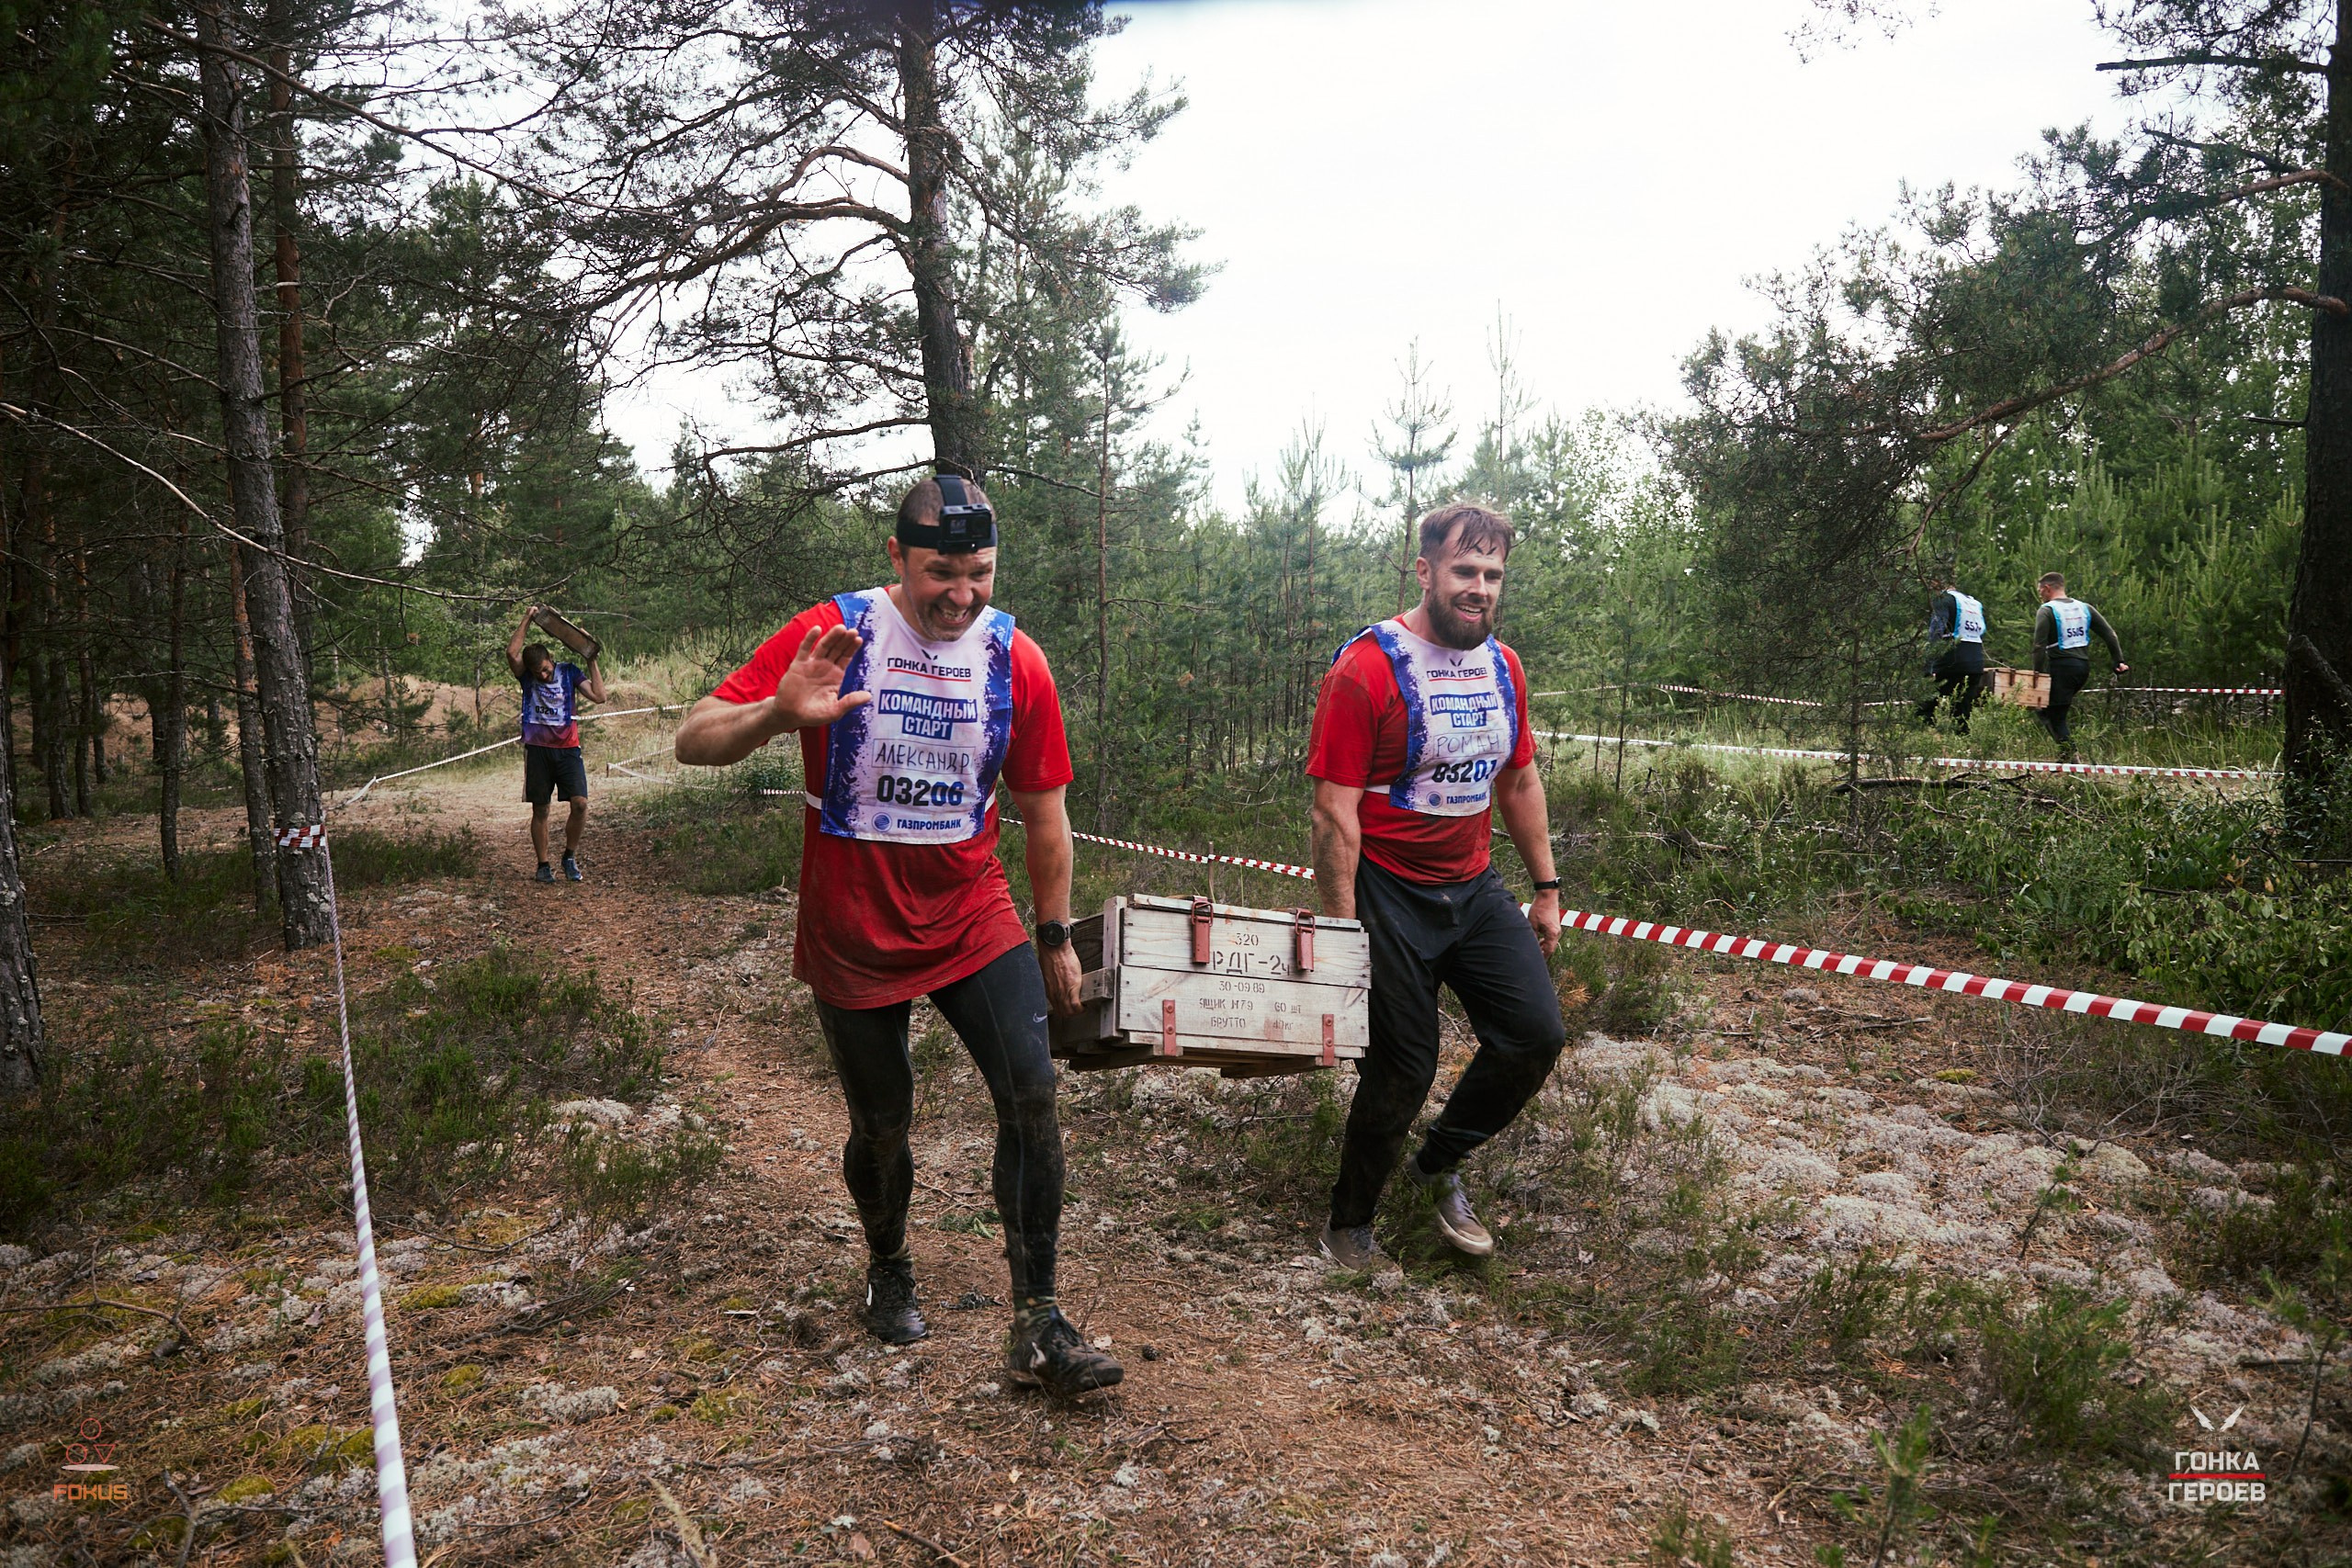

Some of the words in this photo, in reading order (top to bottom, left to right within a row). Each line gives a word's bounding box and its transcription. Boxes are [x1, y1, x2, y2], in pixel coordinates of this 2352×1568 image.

[888, 658, 927, 674] ГОНКА
[931, 665, 971, 678] ГЕРОЕВ
[1427, 669, 1456, 678] ГОНКА
[880, 694, 977, 720] КОМАНДНЫЙ
[1430, 692, 1498, 713] КОМАНДНЫЙ
[905, 716, 950, 738] СТАРТ
[1453, 711, 1485, 727] СТАРТ
[1437, 735, 1500, 756] РОМАН
[875, 742, 970, 774] АЛЕКСАНДР
[1431, 760, 1498, 783] 03207
[876, 775, 964, 807] 03206
[897, 818, 962, 830] ГАЗПРОМБАНК
[1235, 932, 1260, 946] 320
[1210, 1017, 1246, 1028] БРУТТО
